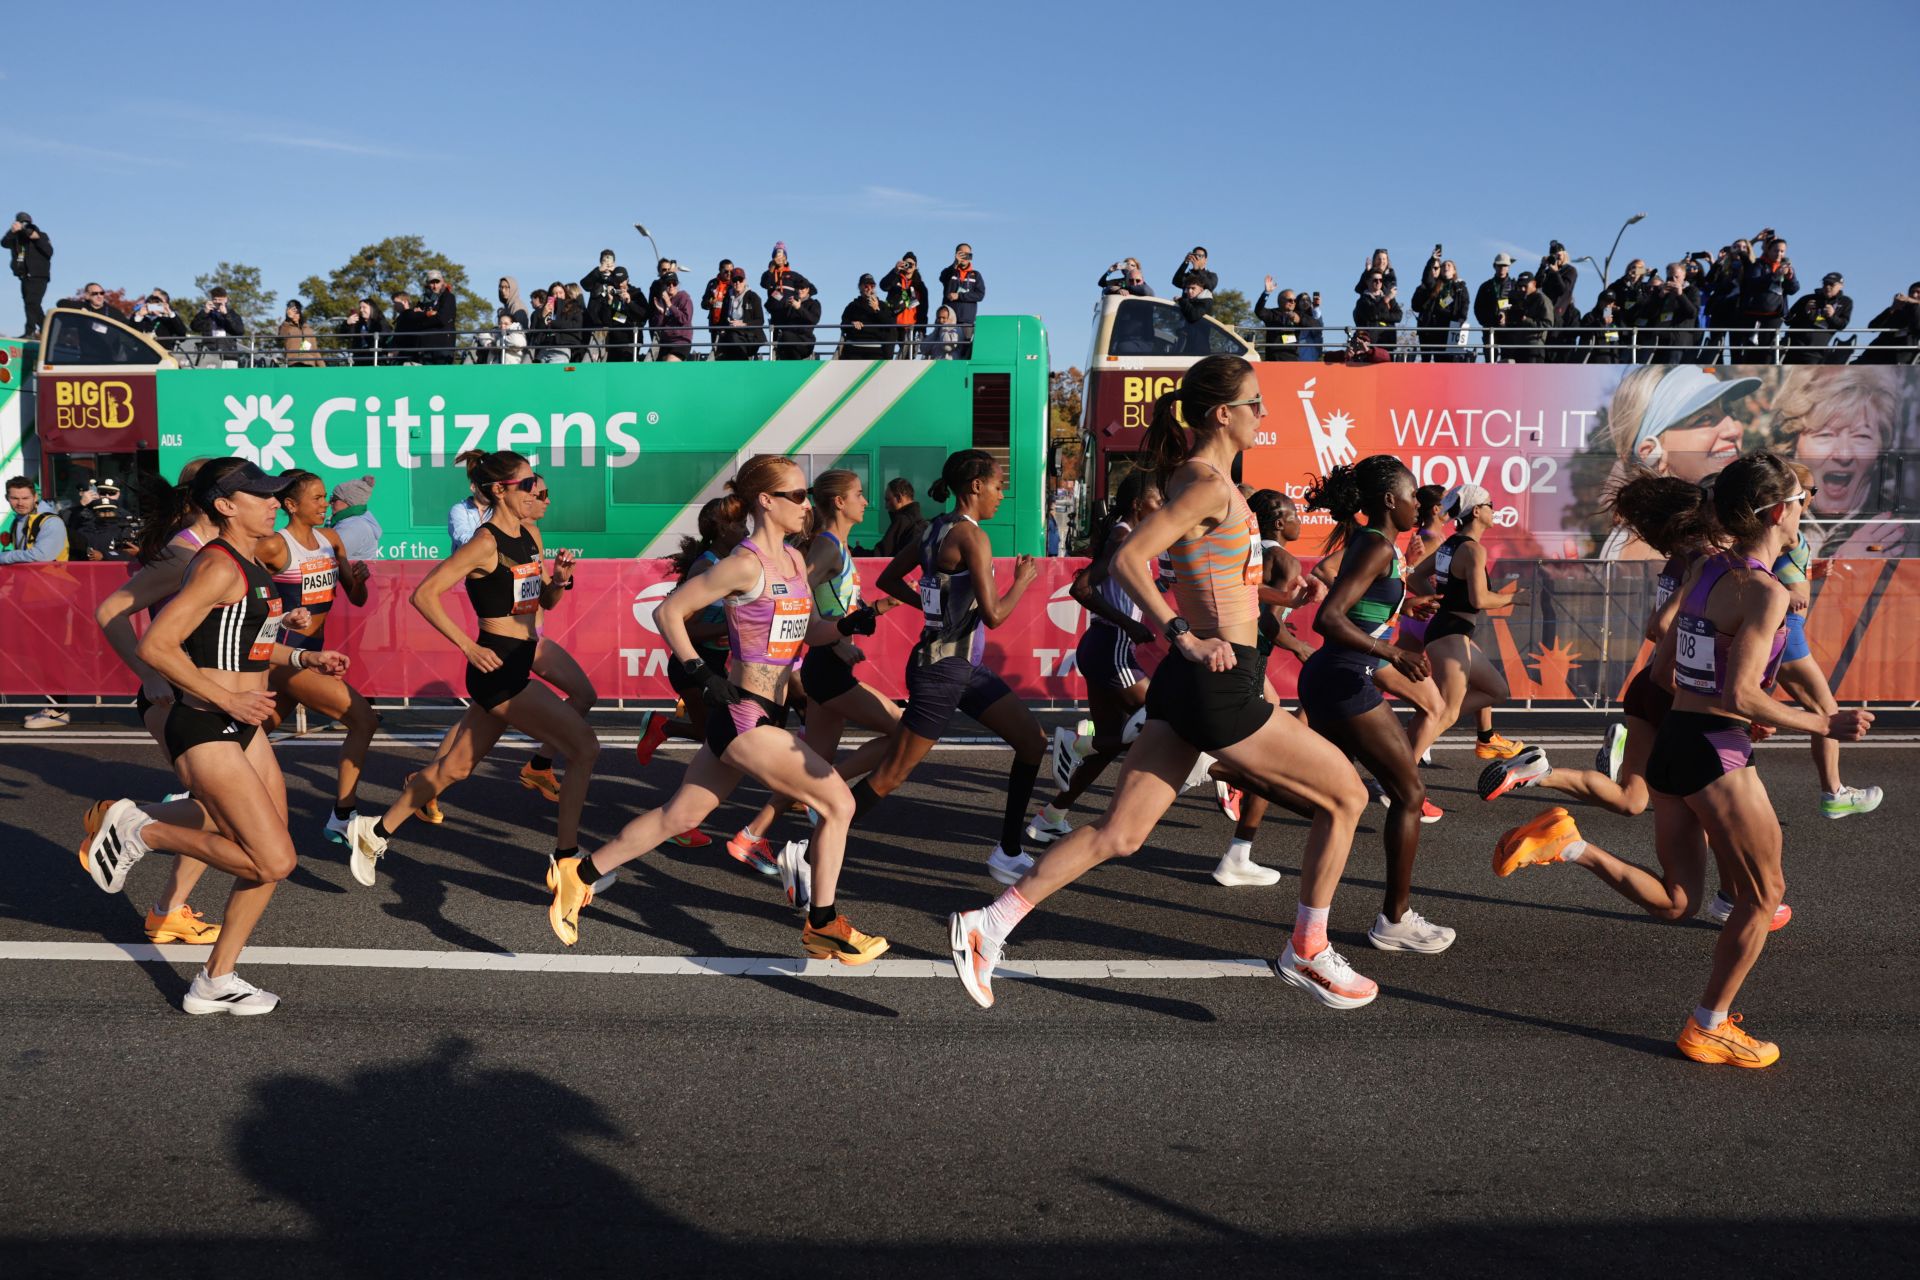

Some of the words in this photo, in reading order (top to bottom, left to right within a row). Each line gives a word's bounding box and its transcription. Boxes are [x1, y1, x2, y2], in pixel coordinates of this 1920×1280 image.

[56, 381, 99, 405] BIG
[57, 406, 100, 429] BUS
[1390, 409, 1544, 448] WATCH
[1561, 410, 1597, 448] IT
[161, 434, 182, 447] ADL5
[1501, 455, 1558, 494] 02
[389, 541, 407, 558] of
[411, 541, 439, 559] the
